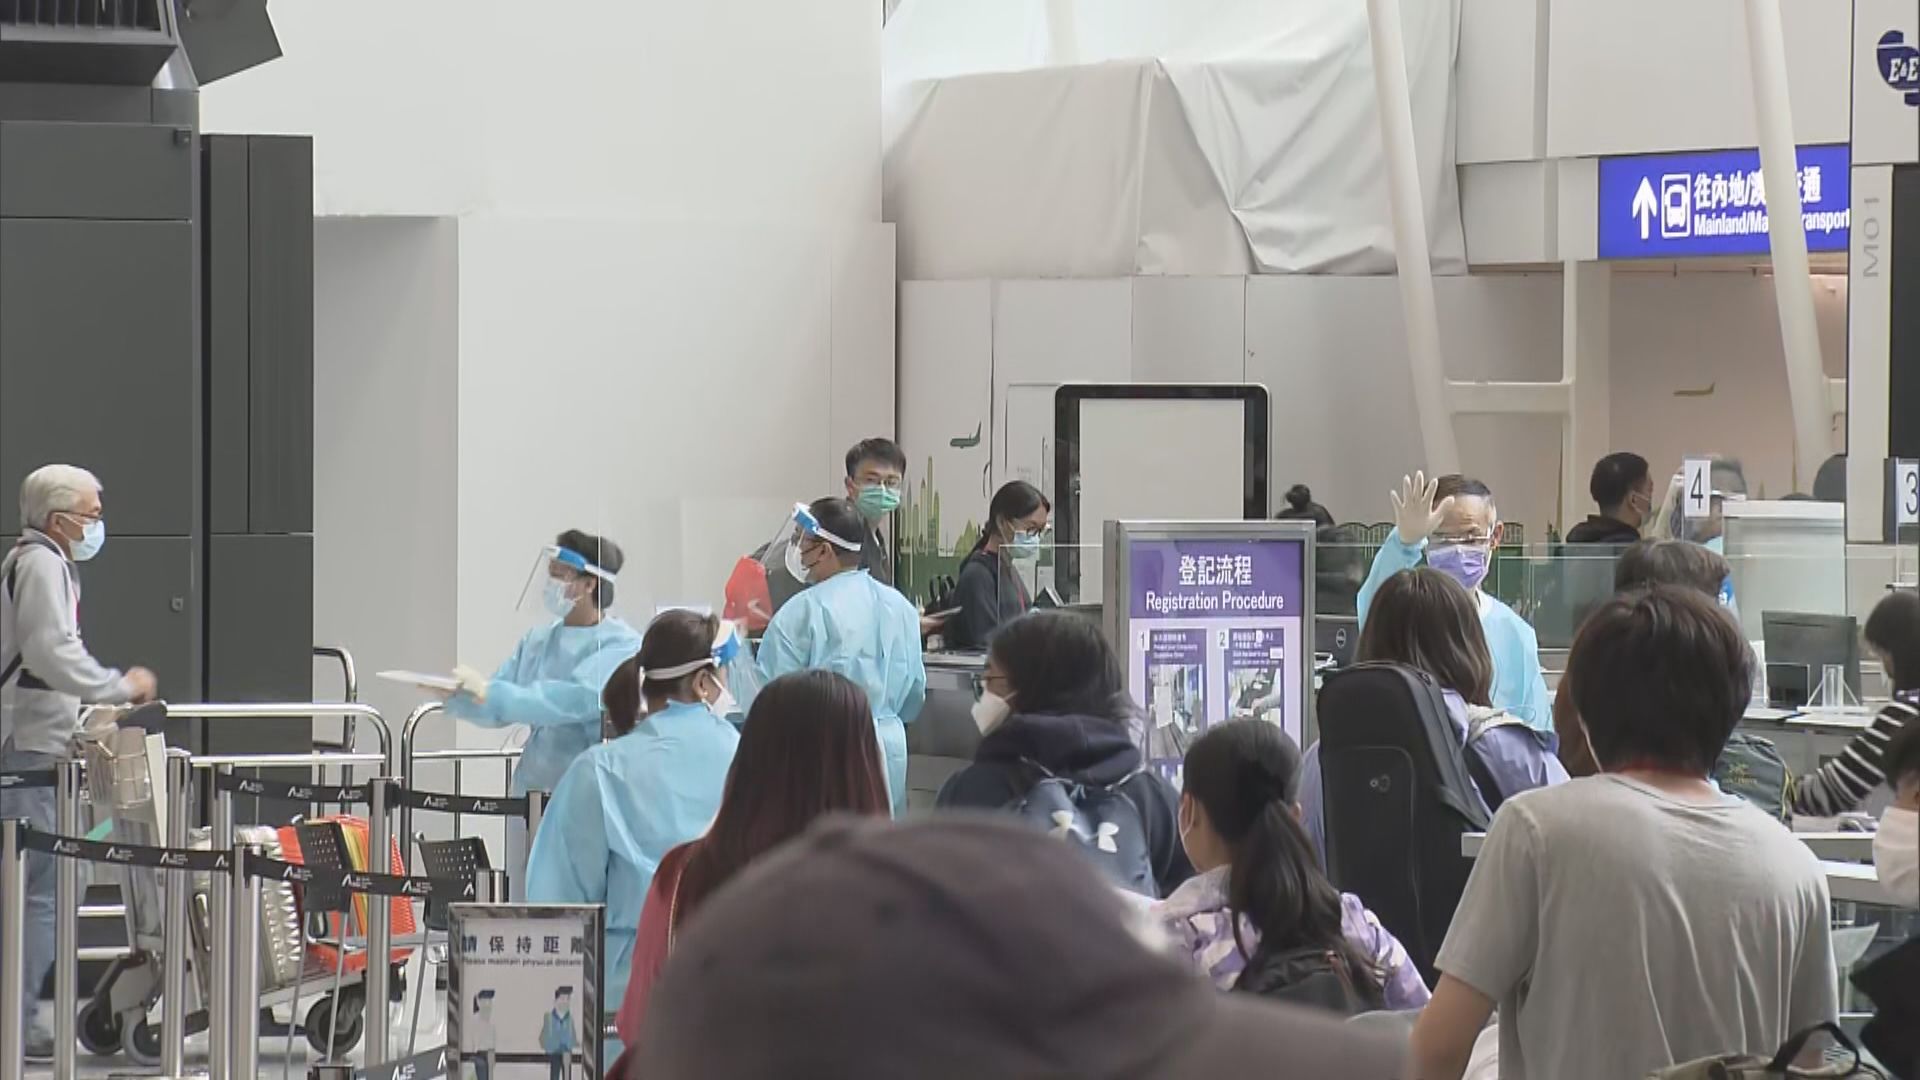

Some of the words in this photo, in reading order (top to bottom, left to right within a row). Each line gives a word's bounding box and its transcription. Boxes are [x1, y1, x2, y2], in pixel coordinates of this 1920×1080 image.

[1801, 207, 1849, 235] ransport
[1690, 467, 1703, 509] 4
[1906, 471, 1919, 516] 3
[1178, 555, 1252, 587] 登記流程
[1145, 591, 1219, 613] Registration
[1222, 590, 1284, 610] Procedure
